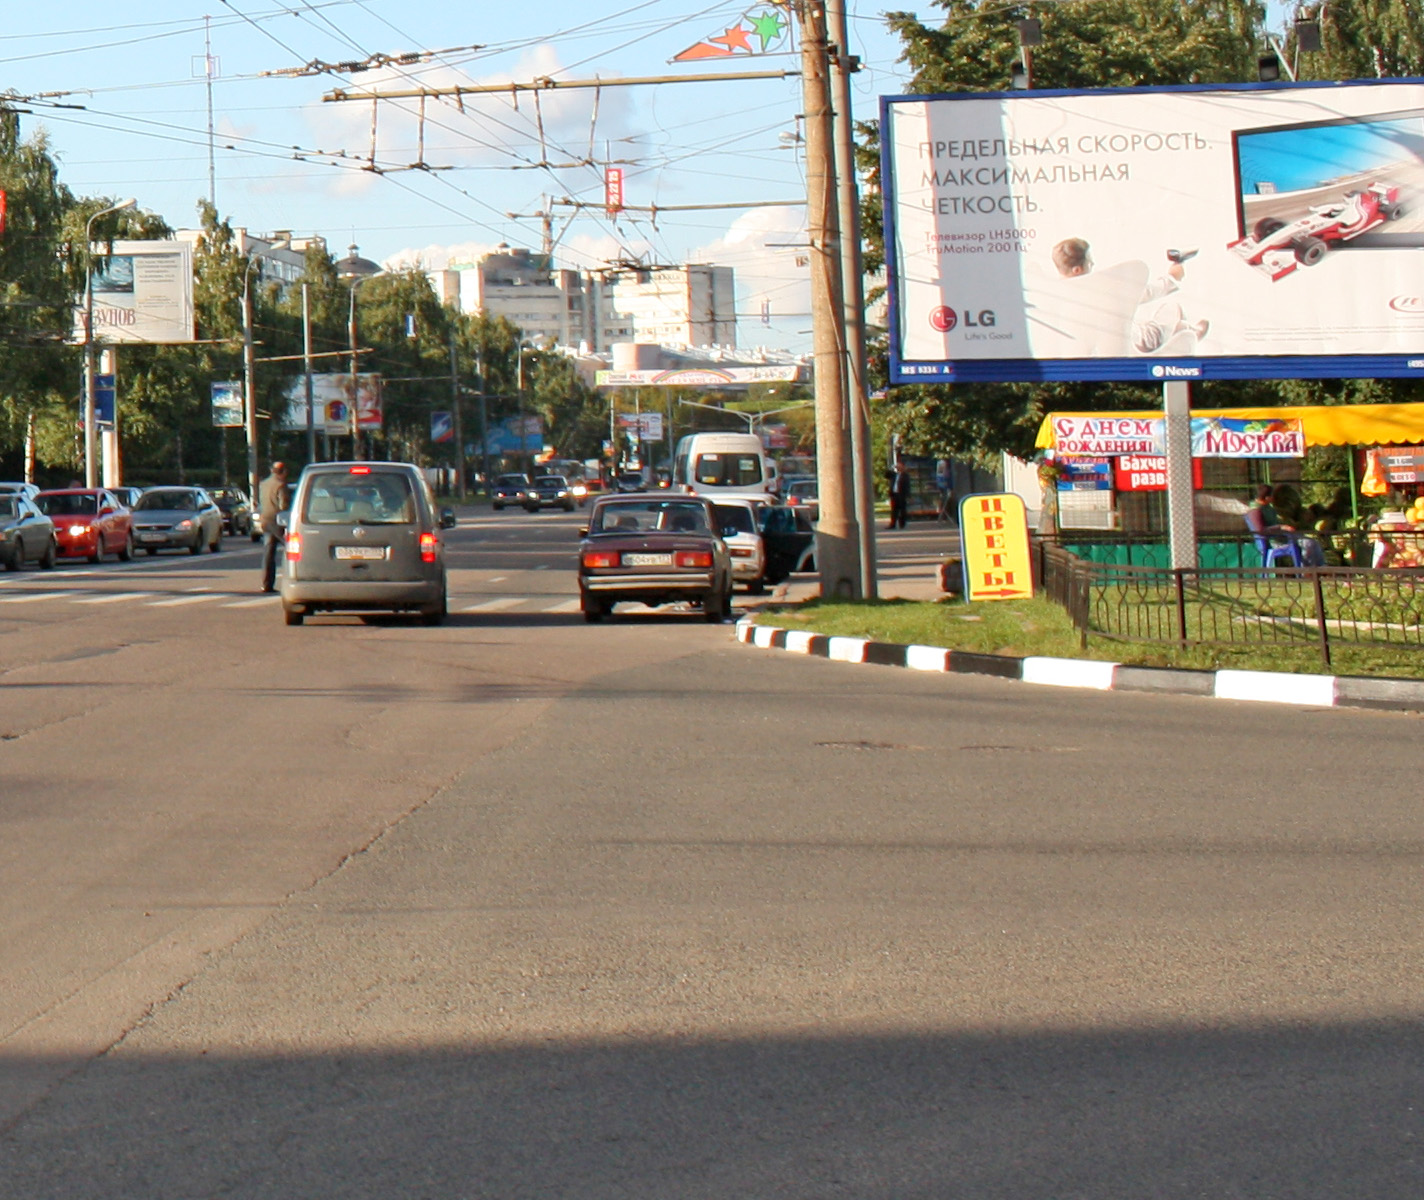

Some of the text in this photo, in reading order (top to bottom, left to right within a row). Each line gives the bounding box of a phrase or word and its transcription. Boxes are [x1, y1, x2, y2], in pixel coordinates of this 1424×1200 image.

[918, 132, 1214, 161] ПРЕДЕЛЬНАЯ СКОРОСТЬ.
[920, 163, 1130, 187] МАКСИМАЛЬНАЯ
[920, 195, 1044, 215] ЧЕТКОСТЬ.
[924, 228, 1037, 243] Телевизор LH5000
[926, 243, 984, 254] TruMotion
[987, 242, 1011, 253] 200
[963, 310, 996, 327] LG
[988, 332, 1013, 340] Good
[1164, 365, 1201, 377] News
[1056, 418, 1075, 438] С
[1058, 440, 1153, 453] РОЖДЕНИЯ!
